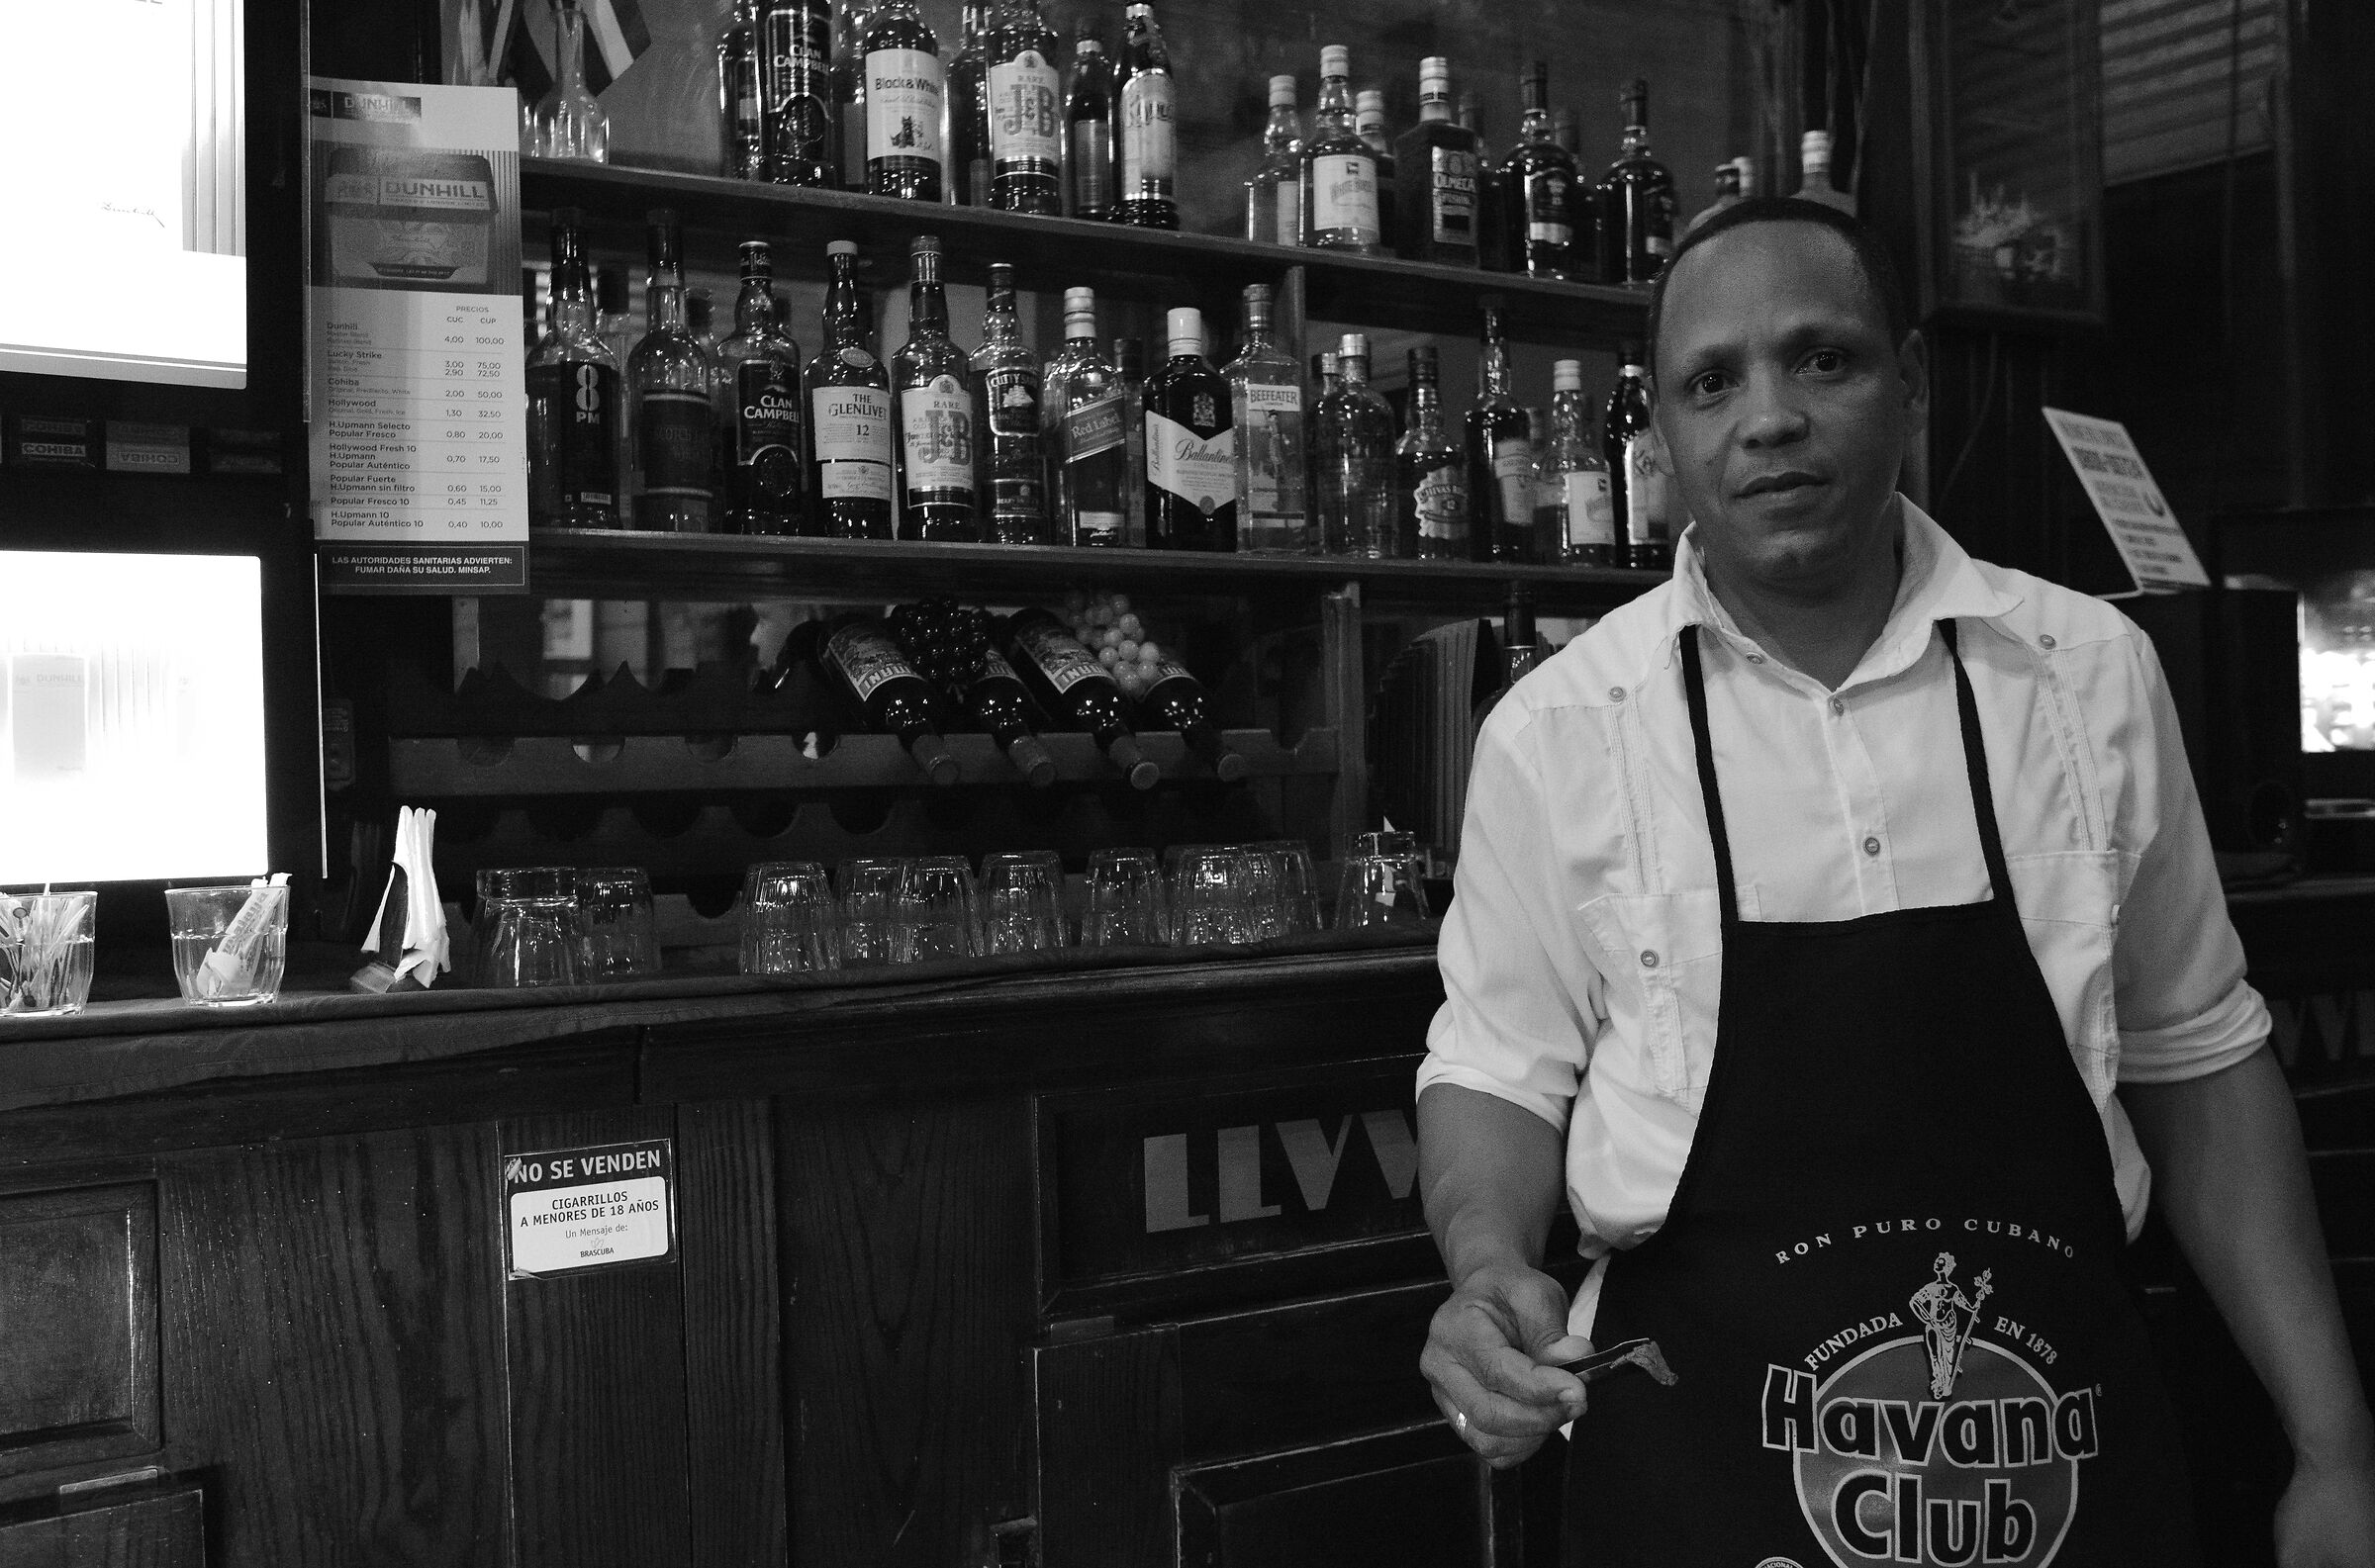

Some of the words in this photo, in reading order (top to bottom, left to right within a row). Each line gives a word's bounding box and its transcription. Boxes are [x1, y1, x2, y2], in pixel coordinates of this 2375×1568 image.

[385, 181, 485, 199] DUNHILL
[327, 322, 358, 330] Dunhill
[444, 335, 464, 344] 4,00
[476, 336, 505, 345] 100,00
[328, 349, 353, 359] Lucky
[356, 350, 382, 359] Strike
[328, 377, 359, 387] Cohiba
[576, 364, 600, 412] 8
[852, 394, 872, 404] THE
[1250, 389, 1298, 405] BEEFEATER
[329, 399, 376, 408] Hollywood
[760, 396, 793, 411] CLAN
[933, 401, 961, 410] RARE
[576, 411, 600, 424] PM
[329, 421, 376, 431] H.Upmann
[378, 422, 411, 431] Selecto
[857, 424, 871, 436] 12
[329, 429, 363, 439] Popular
[479, 431, 504, 440] 20,00
[23, 444, 85, 456] COHIBA
[330, 443, 378, 453] Hollywood
[330, 451, 376, 461] H.Upmann
[330, 461, 364, 471] Popular
[367, 461, 411, 470] Auténtico
[330, 475, 364, 484] Popular
[331, 484, 376, 493] H.Upmann
[479, 485, 502, 494] 15,00
[331, 497, 364, 507] Popular
[331, 511, 377, 520] H.Upmann
[332, 519, 365, 529] Popular
[368, 519, 412, 528] Auténtico
[448, 520, 468, 529] 0,40
[332, 556, 348, 565] LAS
[351, 556, 412, 565] AUTORIDADES
[387, 565, 410, 574] DAÑA
[514, 1161, 543, 1184] NO
[550, 1159, 574, 1180] SE
[581, 1149, 661, 1176] VENDEN
[551, 1191, 628, 1210] CIGARRILLOS
[521, 1217, 528, 1228] A
[533, 1209, 587, 1226] MENORES
[592, 1207, 606, 1219] DE
[611, 1204, 624, 1217] 18
[628, 1199, 660, 1214] AÑOS
[565, 1230, 577, 1239] Un
[580, 1226, 613, 1239] Mensaje
[616, 1223, 628, 1233] de:
[1775, 1233, 1833, 1264] RON
[1852, 1217, 1942, 1239] PURO
[1964, 1218, 2074, 1258] CUBANO
[580, 1246, 615, 1257] BRASCUBA
[1804, 1311, 1903, 1371] FUNDADA
[1993, 1316, 2026, 1339] EN
[2028, 1332, 2057, 1365] 1878
[1761, 1362, 2099, 1468] Havana
[1831, 1468, 2038, 1568] Club
